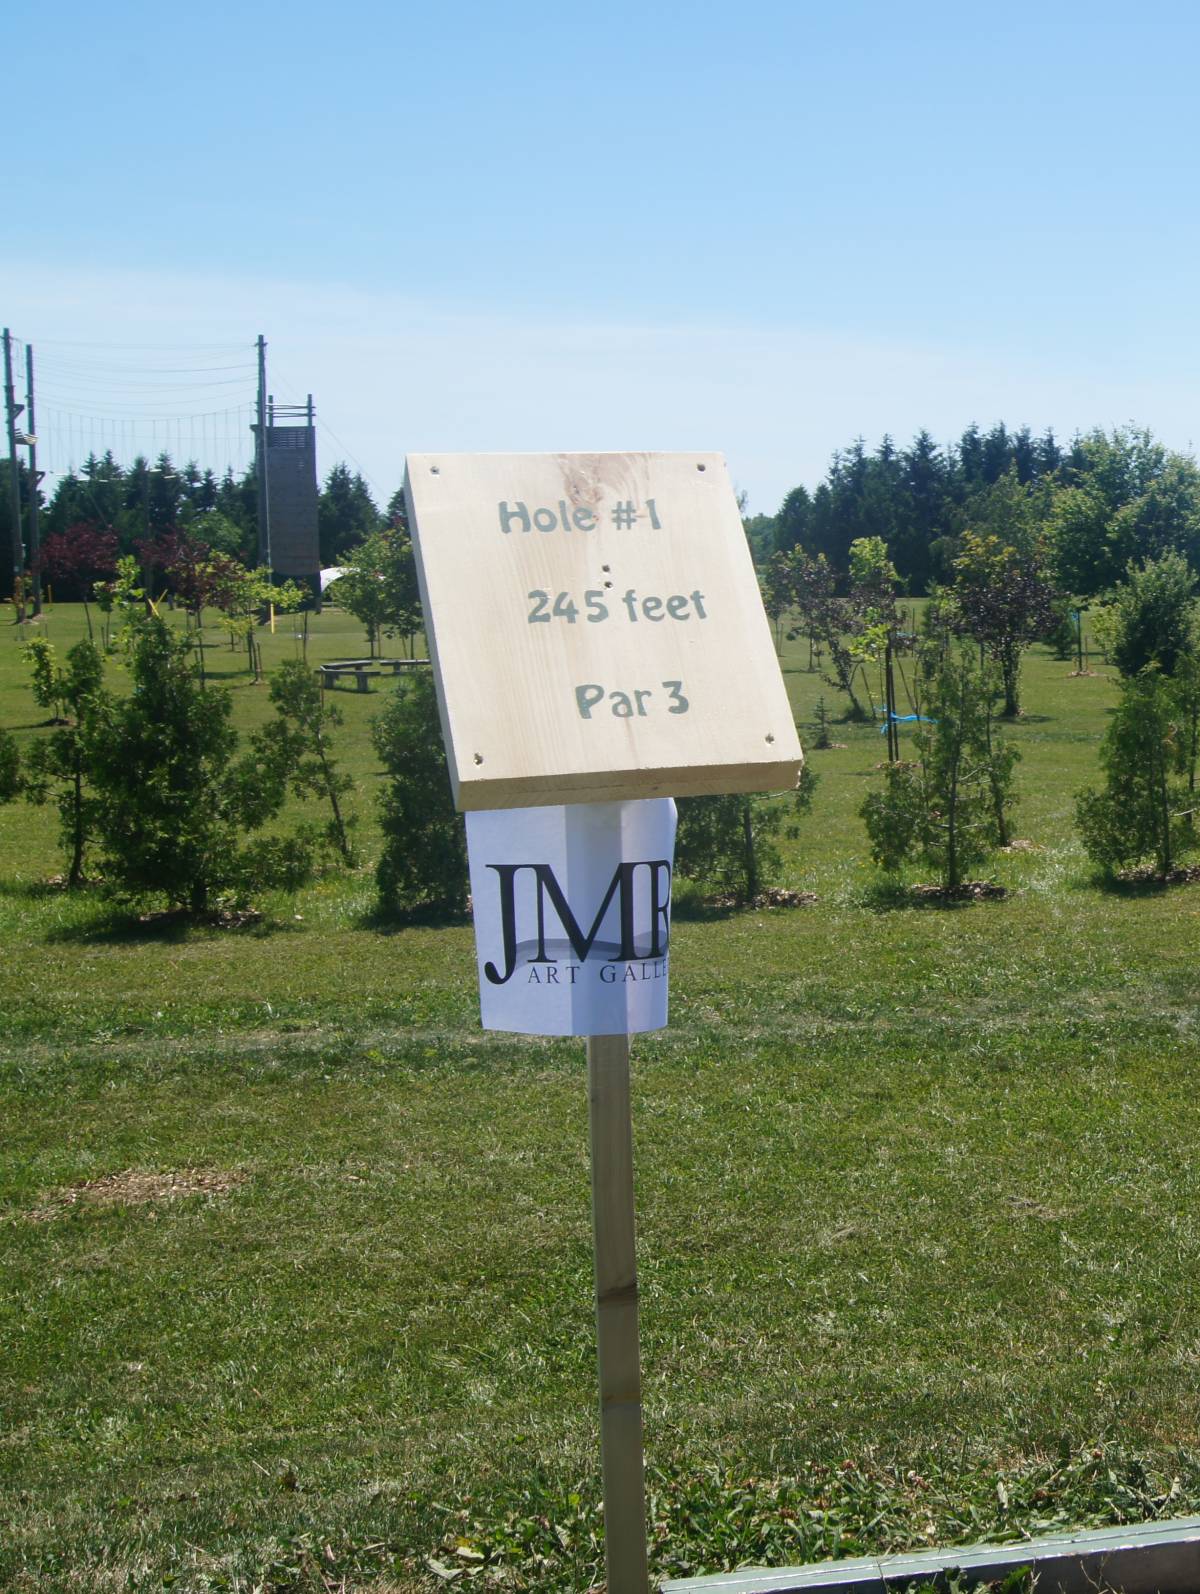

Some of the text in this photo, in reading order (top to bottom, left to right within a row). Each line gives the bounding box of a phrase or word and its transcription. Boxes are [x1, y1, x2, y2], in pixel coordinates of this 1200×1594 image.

[498, 499, 662, 534] Hole #1
[527, 589, 707, 624] 245 feet
[575, 680, 690, 719] Par 3
[528, 965, 580, 984] ART
